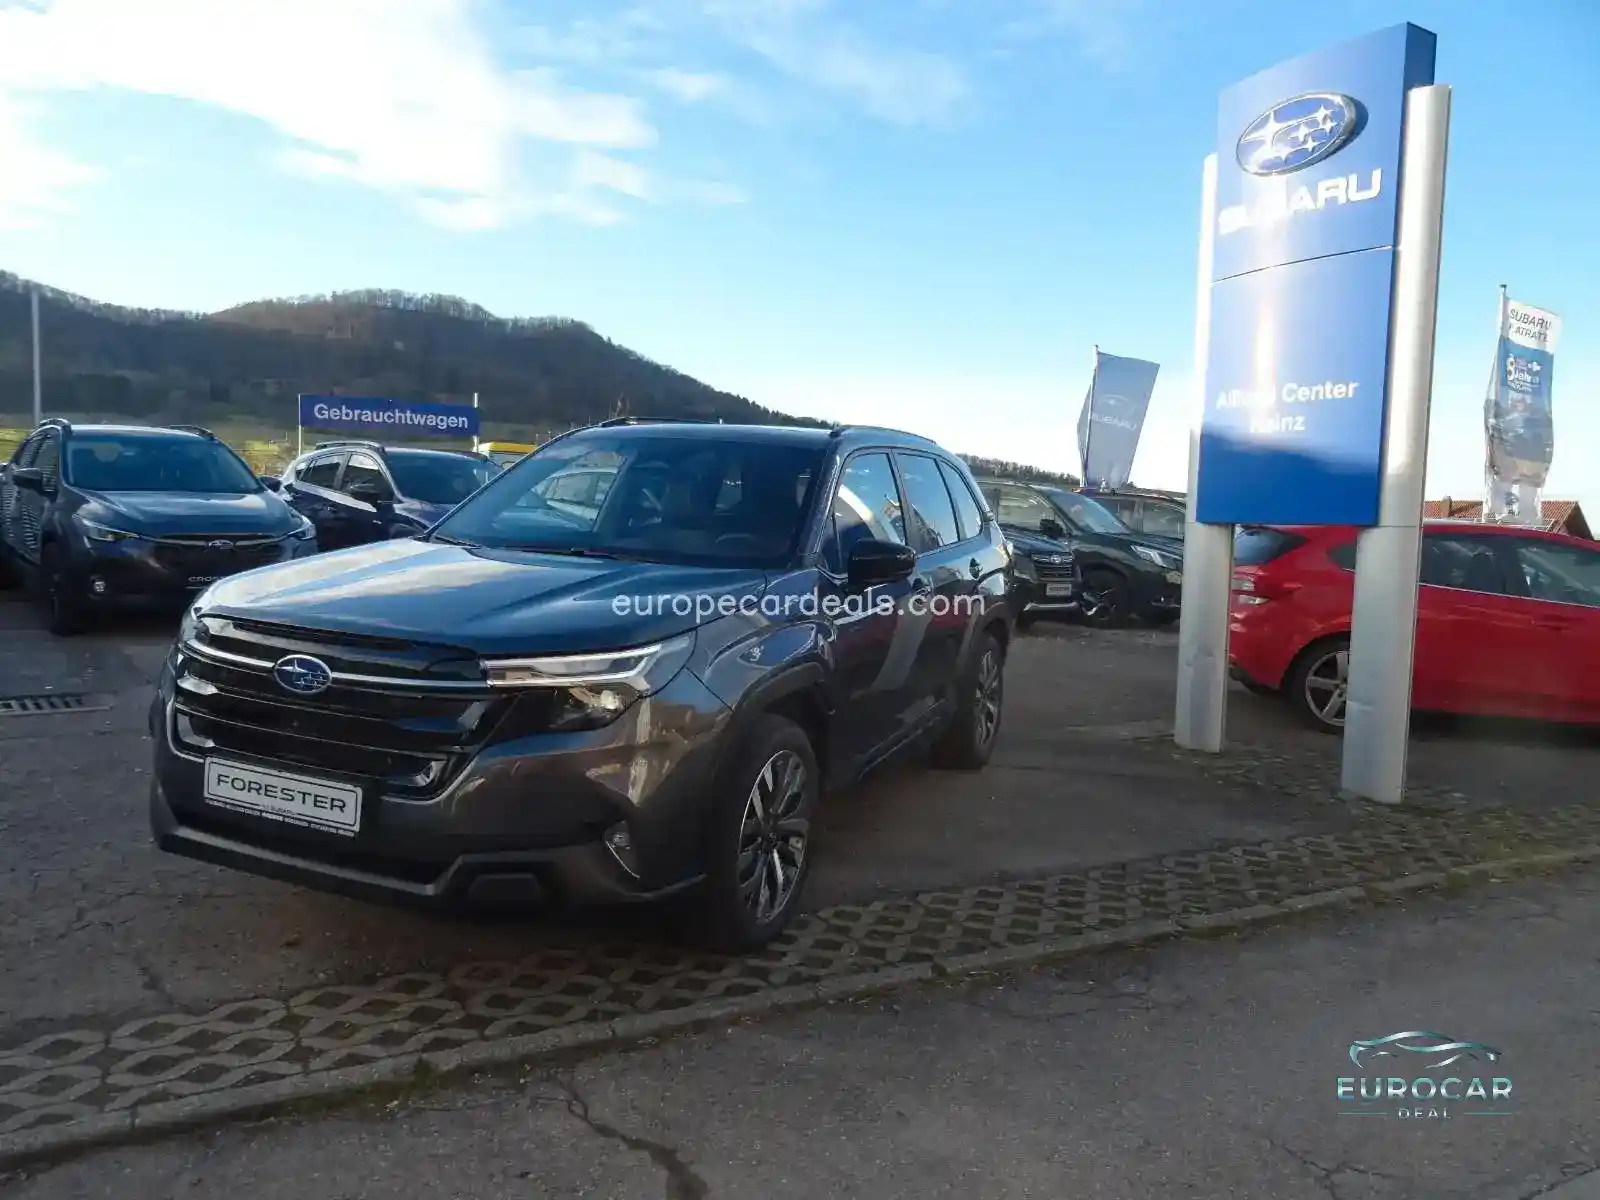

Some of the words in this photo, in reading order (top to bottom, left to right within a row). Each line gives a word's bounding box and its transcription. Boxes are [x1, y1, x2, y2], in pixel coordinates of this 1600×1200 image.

[1281, 381, 1359, 403] Center
[314, 404, 468, 429] Gebrauchtwagen
[216, 773, 347, 814] FORESTER
